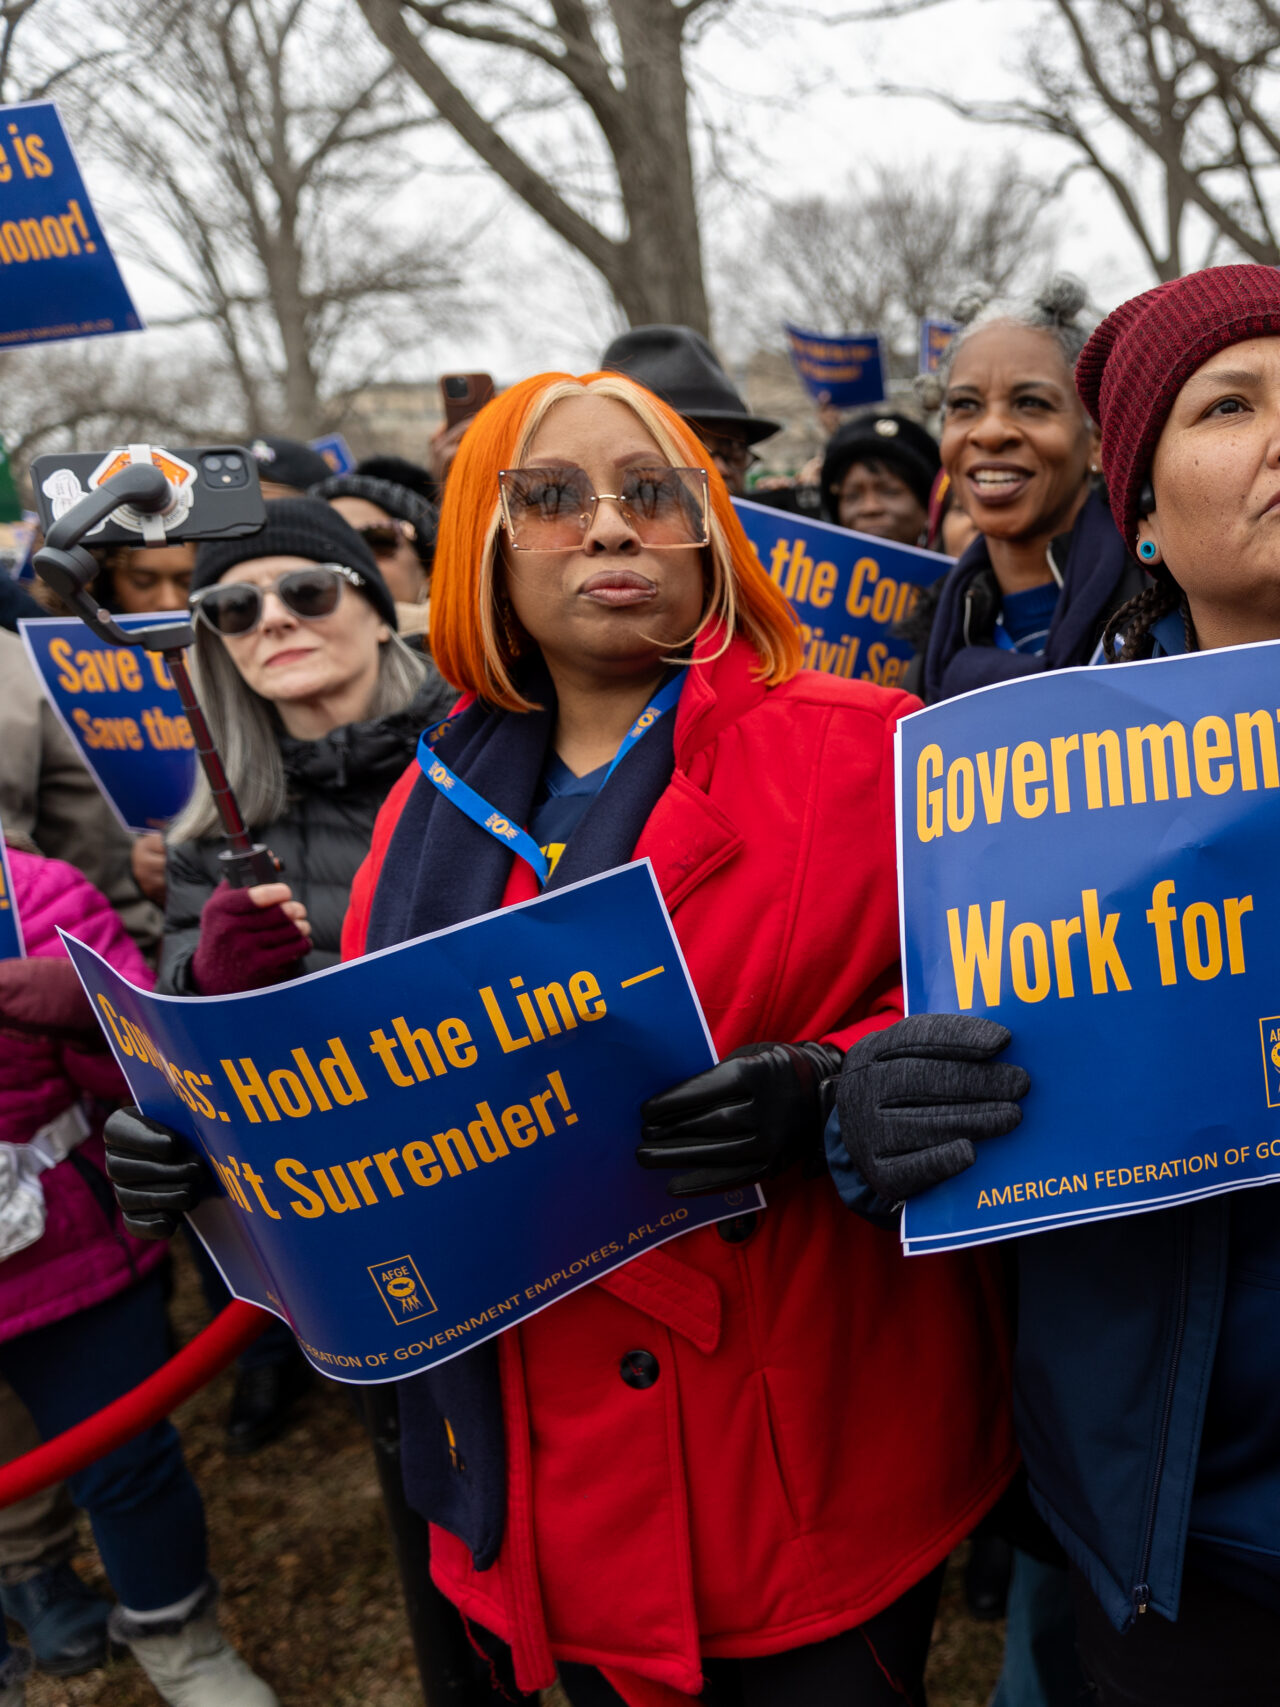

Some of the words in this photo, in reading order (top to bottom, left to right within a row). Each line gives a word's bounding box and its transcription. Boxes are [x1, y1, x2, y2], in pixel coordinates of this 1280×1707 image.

[8, 123, 53, 178] is
[0, 200, 96, 264] onor!
[770, 537, 838, 608] the
[49, 637, 143, 693] Save
[72, 708, 144, 750] Save
[142, 706, 196, 750] the
[946, 888, 1132, 1010] Work
[1146, 879, 1254, 986] for
[97, 993, 232, 1123] Conss:
[219, 1037, 369, 1123] Hold
[369, 1016, 478, 1087] the
[478, 970, 607, 1054] Line
[205, 1152, 282, 1220] n't
[275, 1070, 579, 1219] Surrender!
[977, 1172, 1088, 1209] AMERICAN
[1094, 1152, 1219, 1189] FEDERATION
[1224, 1145, 1251, 1165] OF
[299, 1337, 362, 1368] RATION
[365, 1352, 390, 1368] OF
[393, 1293, 519, 1361] GOVERNMENT
[525, 1243, 623, 1299] EMPLOYEES,
[627, 1207, 689, 1244] AFL-CIO
[381, 1265, 409, 1283] AFGE
